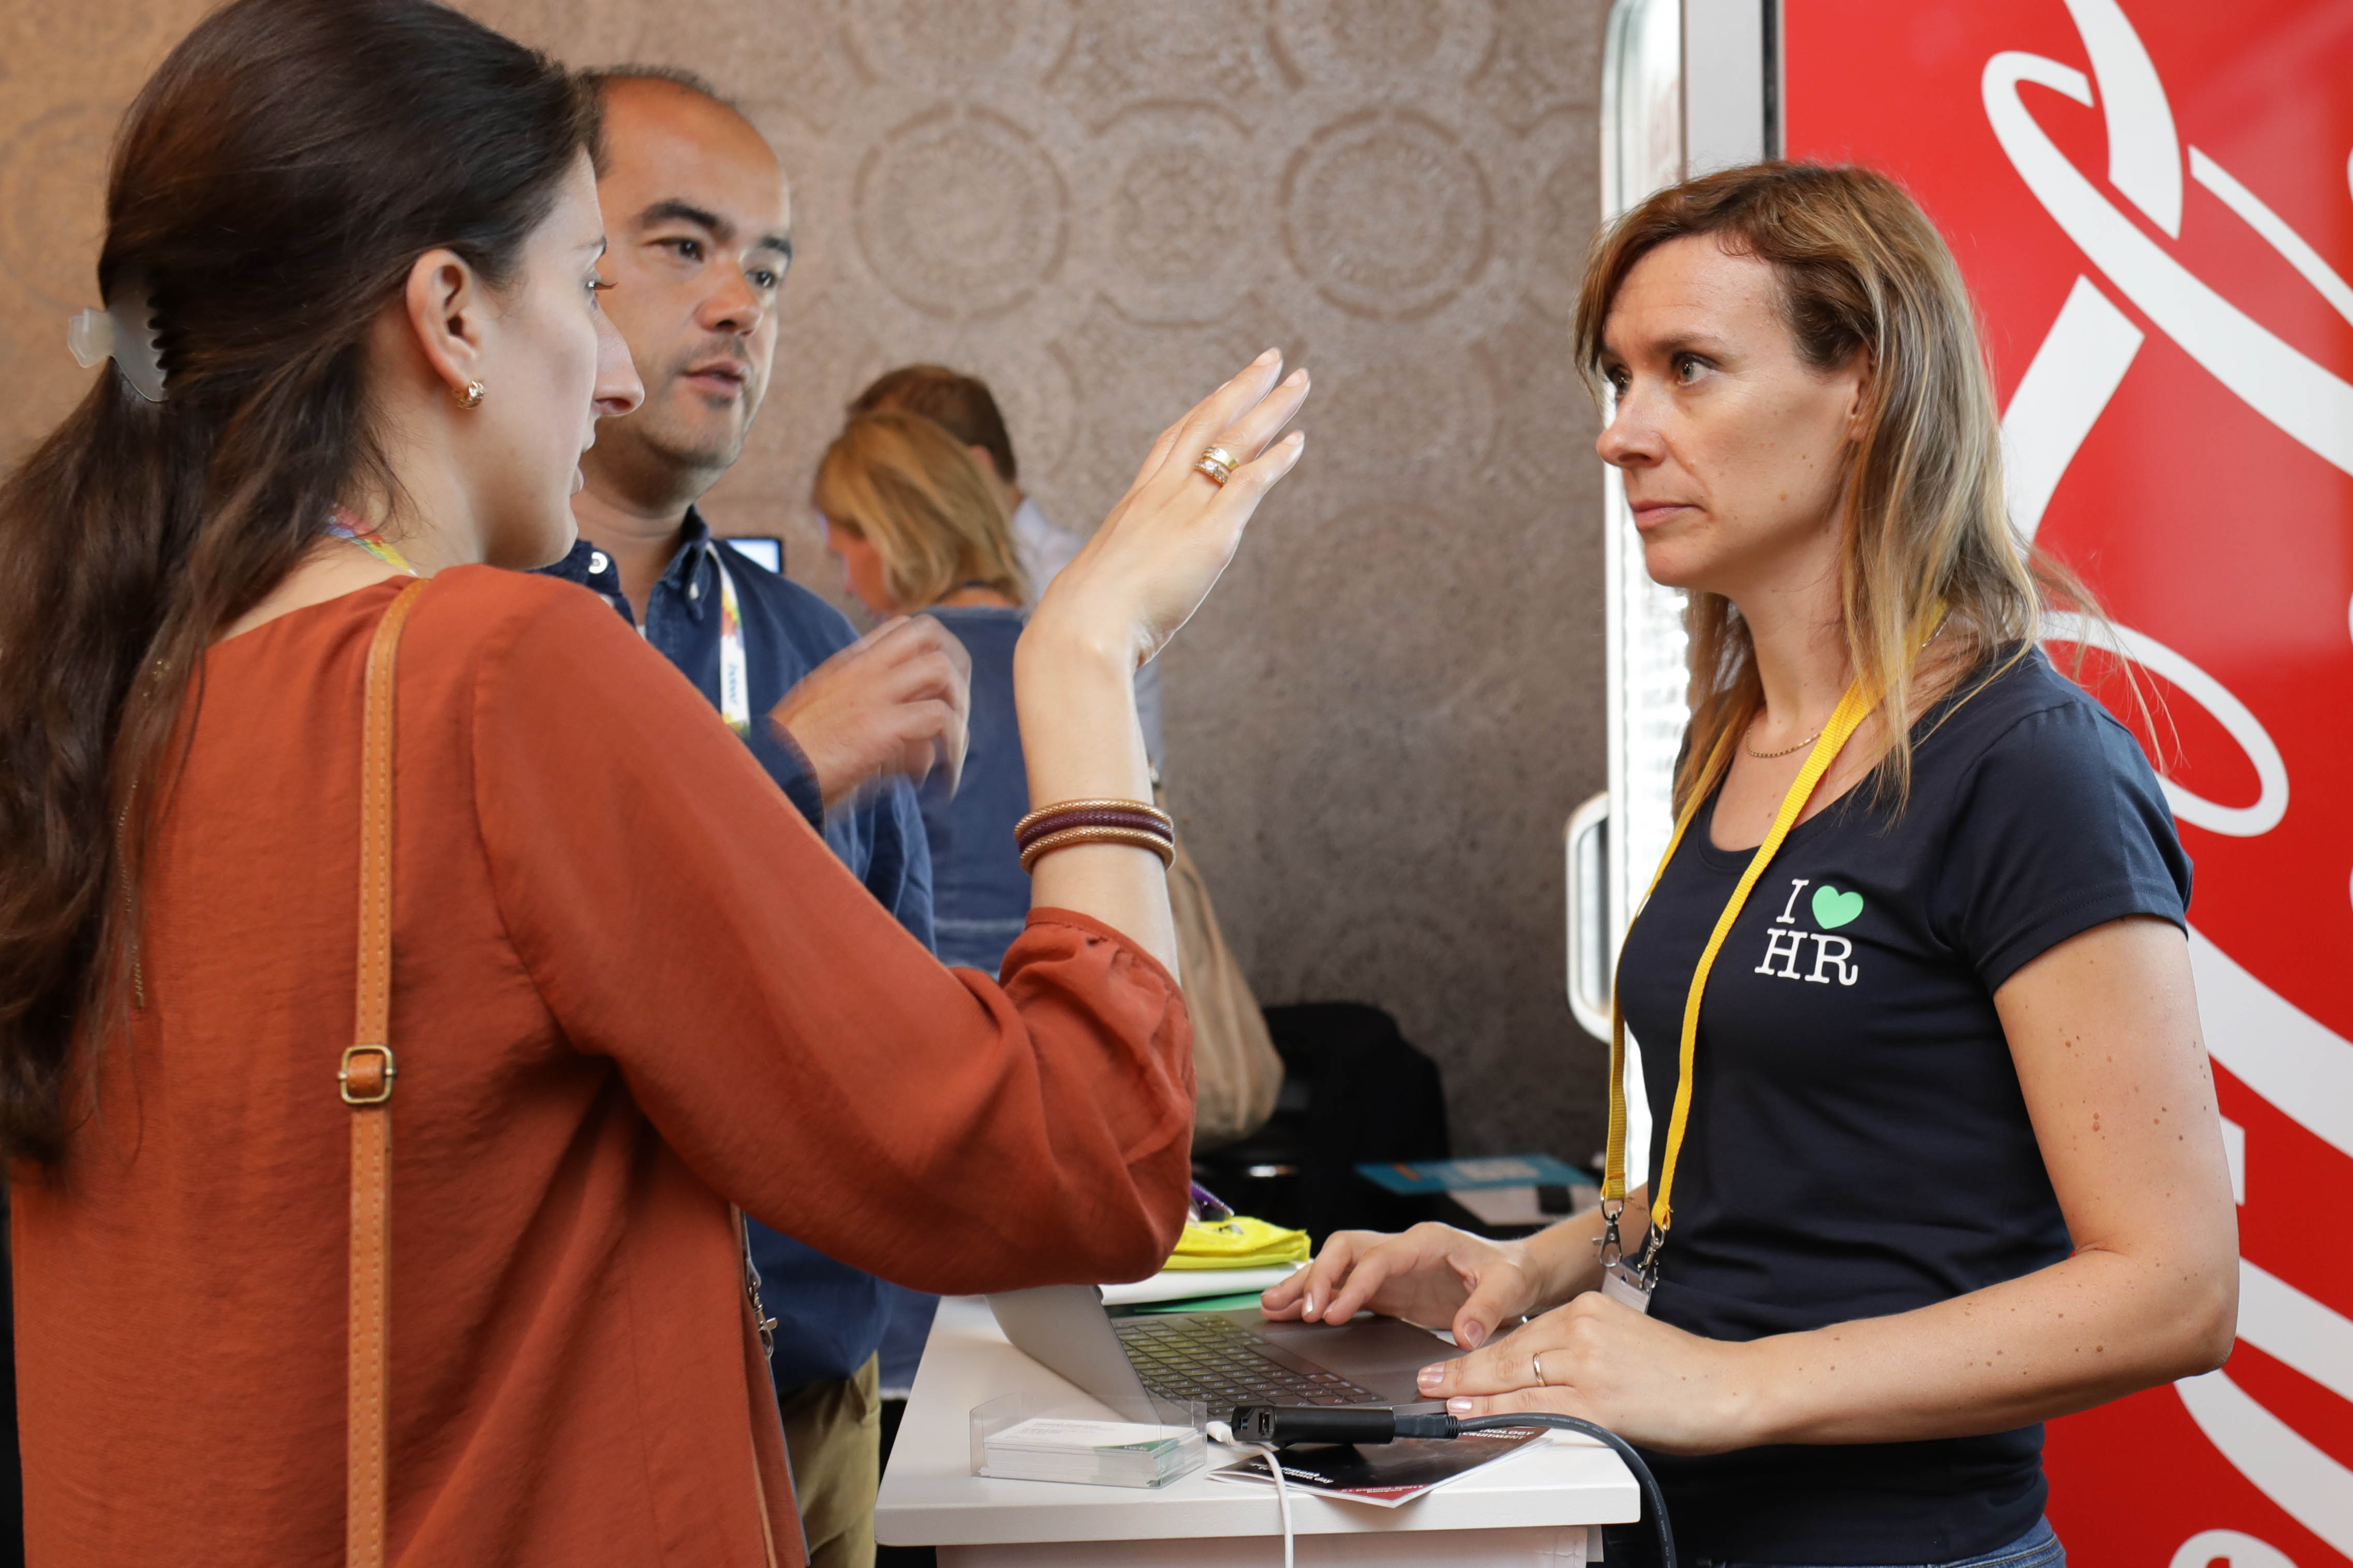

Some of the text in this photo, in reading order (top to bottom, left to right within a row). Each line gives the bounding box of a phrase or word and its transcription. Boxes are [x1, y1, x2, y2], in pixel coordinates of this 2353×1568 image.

[1776, 878, 1810, 924] I
[1754, 928, 1859, 985] HR
[1459, 1431, 1527, 1440] CRUITMENT
